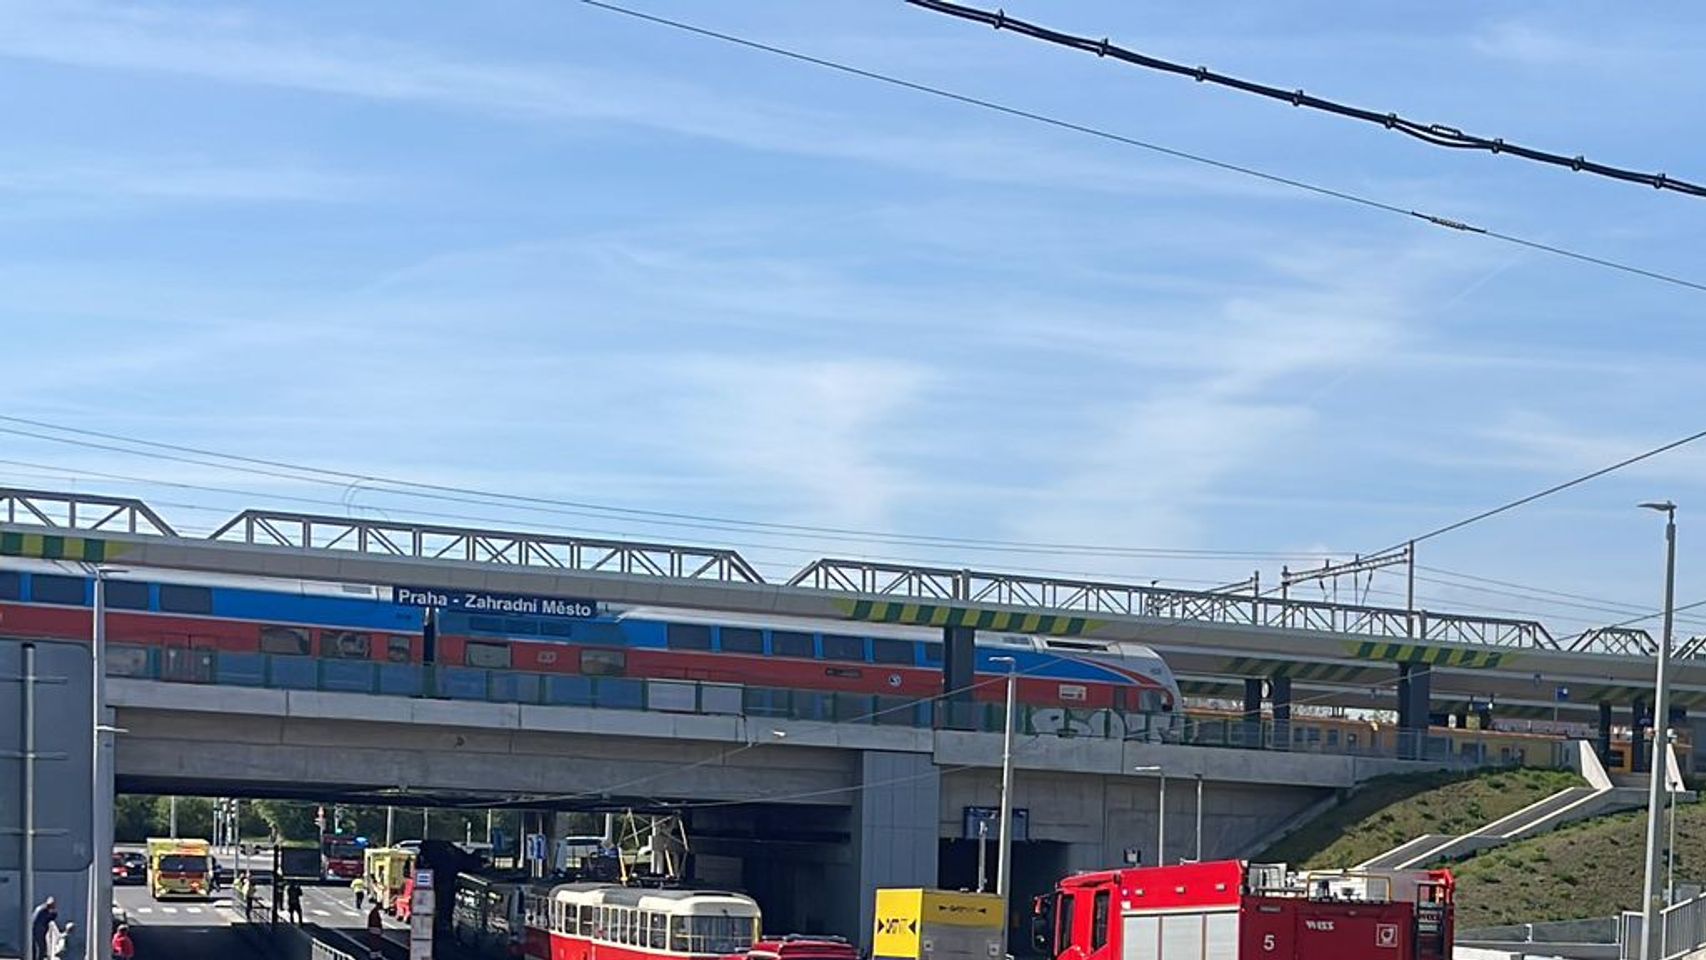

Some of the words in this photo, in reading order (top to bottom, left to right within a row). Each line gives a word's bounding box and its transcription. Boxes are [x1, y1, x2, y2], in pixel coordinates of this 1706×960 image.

[399, 589, 447, 606] Praha
[465, 594, 537, 613] Zahradní
[542, 600, 592, 617] Město
[1263, 934, 1275, 951] 5
